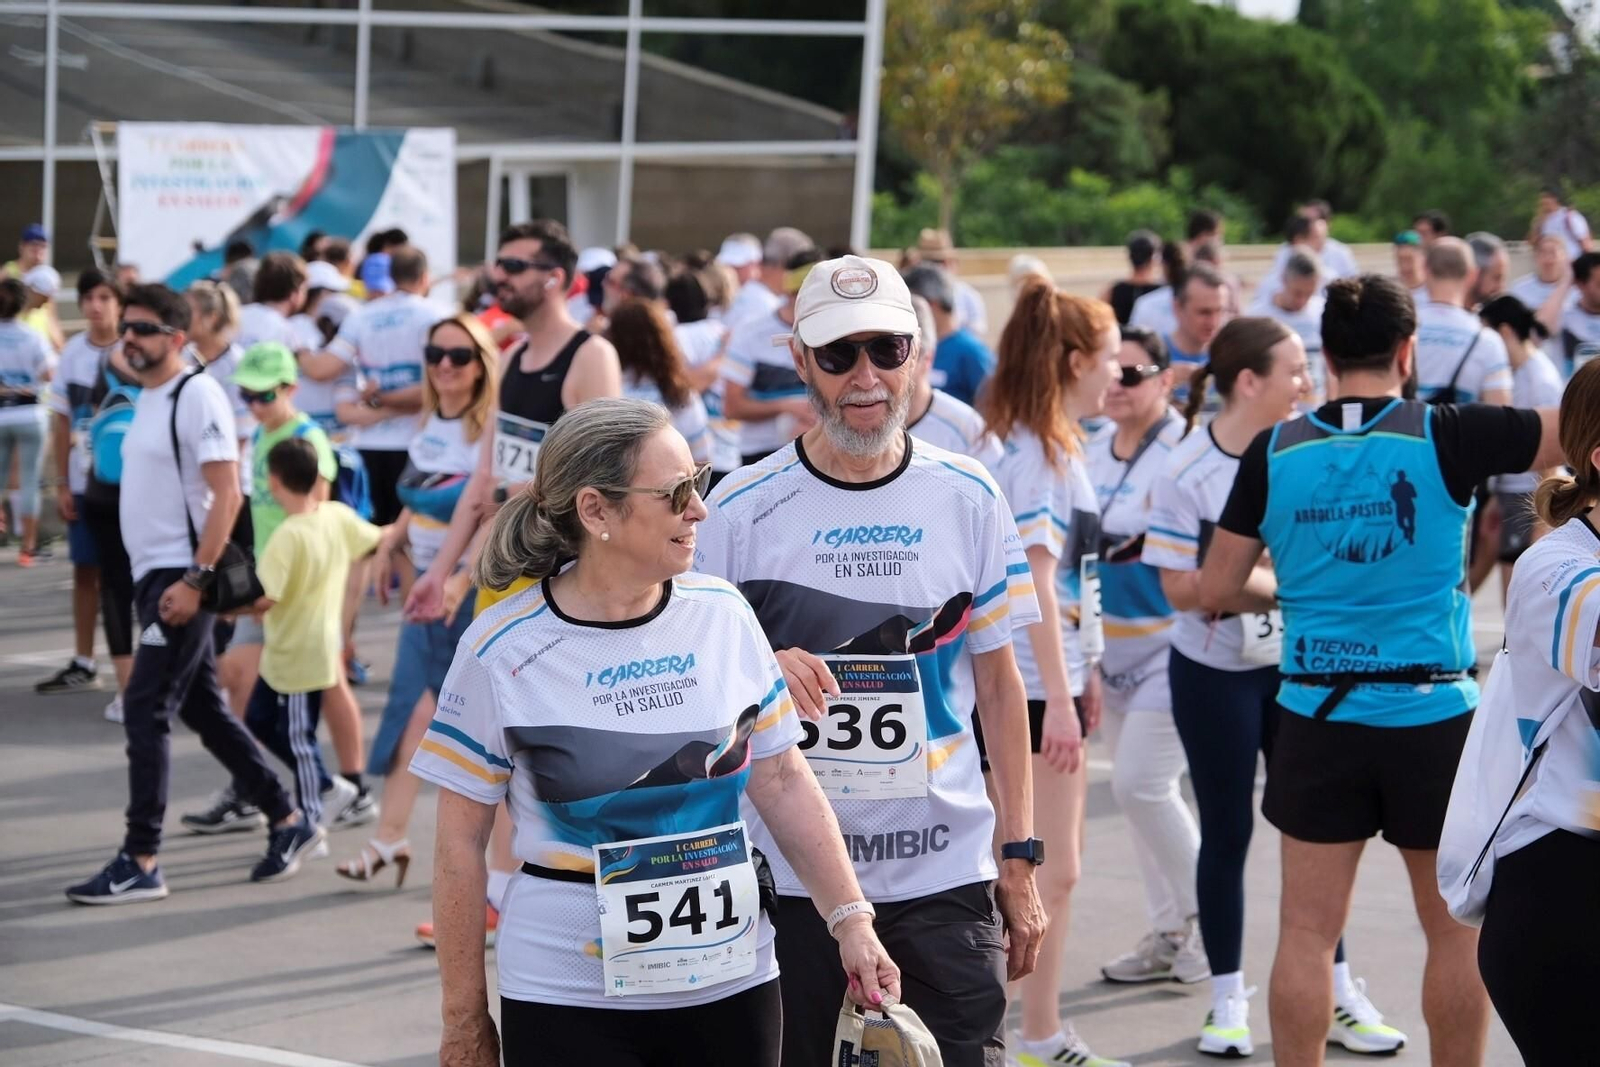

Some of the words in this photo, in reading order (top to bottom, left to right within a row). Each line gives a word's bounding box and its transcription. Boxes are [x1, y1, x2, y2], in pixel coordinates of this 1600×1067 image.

[1294, 500, 1394, 523] ARROLLA-PASTOS
[812, 529, 822, 546] I
[824, 525, 923, 549] CARRERA
[816, 553, 835, 564] POR
[838, 552, 849, 563] LA
[851, 550, 919, 562] INVESTIGACIÓN
[835, 563, 852, 578] EN
[857, 562, 902, 577] SALUD
[511, 636, 569, 678] FIREHAWK
[1310, 639, 1379, 658] TIENDA
[585, 672, 593, 688] I
[597, 653, 695, 689] CARRERA
[844, 664, 885, 672] CARRERA
[845, 671, 912, 680] INVESTIGACIÓN
[592, 695, 614, 707] POR
[615, 691, 628, 702] LA
[629, 677, 698, 698] INVESTIGACIÓN
[842, 681, 854, 689] EN
[855, 681, 884, 689] SALUD
[616, 702, 635, 717] EN
[640, 691, 684, 712] SALUD
[682, 837, 718, 851] CARRERA
[650, 853, 671, 866] POR
[671, 853, 683, 863] LA
[684, 842, 738, 861] INVESTIGACIÓN
[682, 861, 694, 870] EN
[694, 856, 718, 868] SALUD
[650, 880, 674, 889] CARMEN
[674, 876, 702, 887] MARTINEZ
[625, 879, 739, 944] 541
[647, 961, 671, 971] IMIBIC
